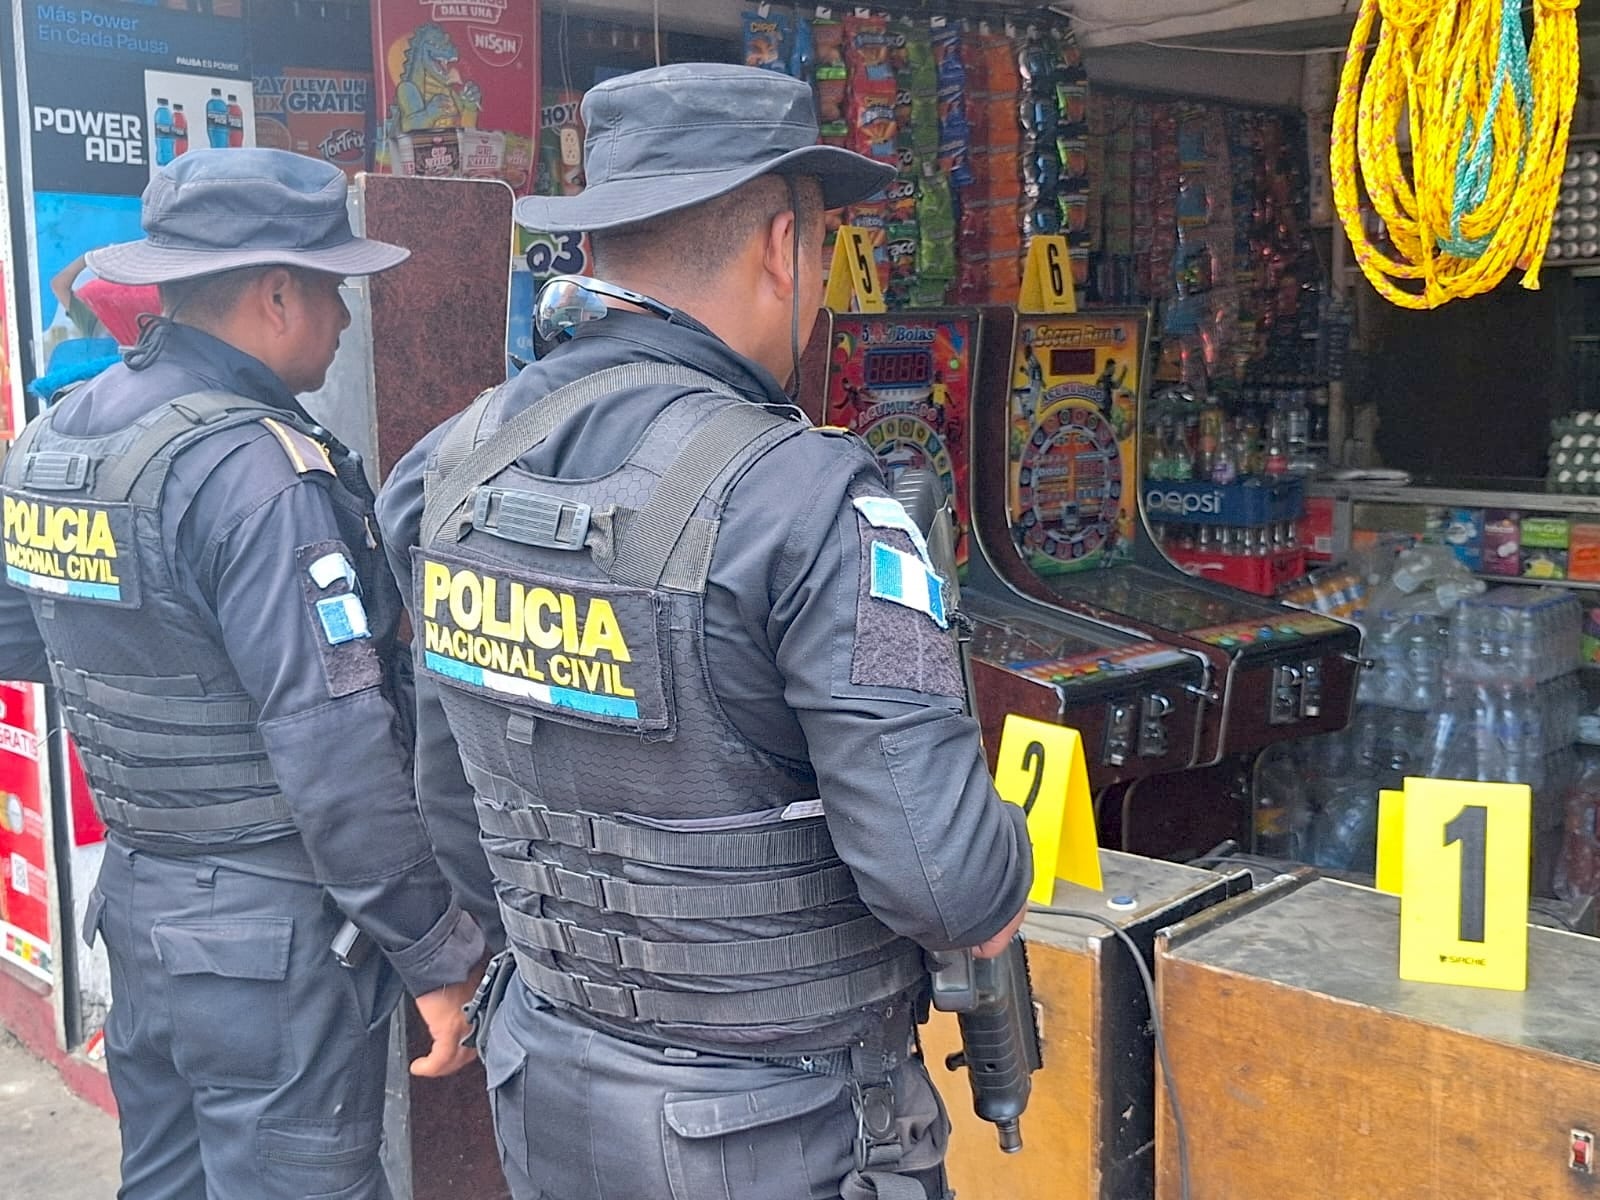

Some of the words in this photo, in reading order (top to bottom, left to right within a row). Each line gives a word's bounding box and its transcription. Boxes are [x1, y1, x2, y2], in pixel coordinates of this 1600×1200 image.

[36, 4, 77, 25] Más
[80, 9, 139, 31] Power
[441, 5, 468, 16] DALE
[470, 7, 492, 18] UNA
[38, 24, 61, 41] En
[65, 27, 113, 48] Cada
[117, 33, 169, 55] Pausa
[475, 33, 516, 54] NISSIN
[290, 78, 339, 94] LLEVA
[342, 79, 368, 95] UN
[286, 92, 367, 114] GRATIS
[541, 102, 578, 127] HOY
[34, 106, 142, 140] POWER
[85, 136, 143, 165] ADE
[852, 234, 873, 294] 5
[1047, 243, 1063, 296] 6
[895, 325, 936, 342] Bolas
[1147, 489, 1221, 516] pepsi
[4, 495, 117, 558] POLICIA
[4, 540, 64, 577] NACIONAL
[66, 554, 119, 584] CIVIL
[424, 560, 632, 662] POLICIA
[424, 620, 545, 681] NACIONAL
[548, 653, 635, 697] CIVIL
[1021, 741, 1045, 818] 2
[1443, 805, 1487, 943] 1
